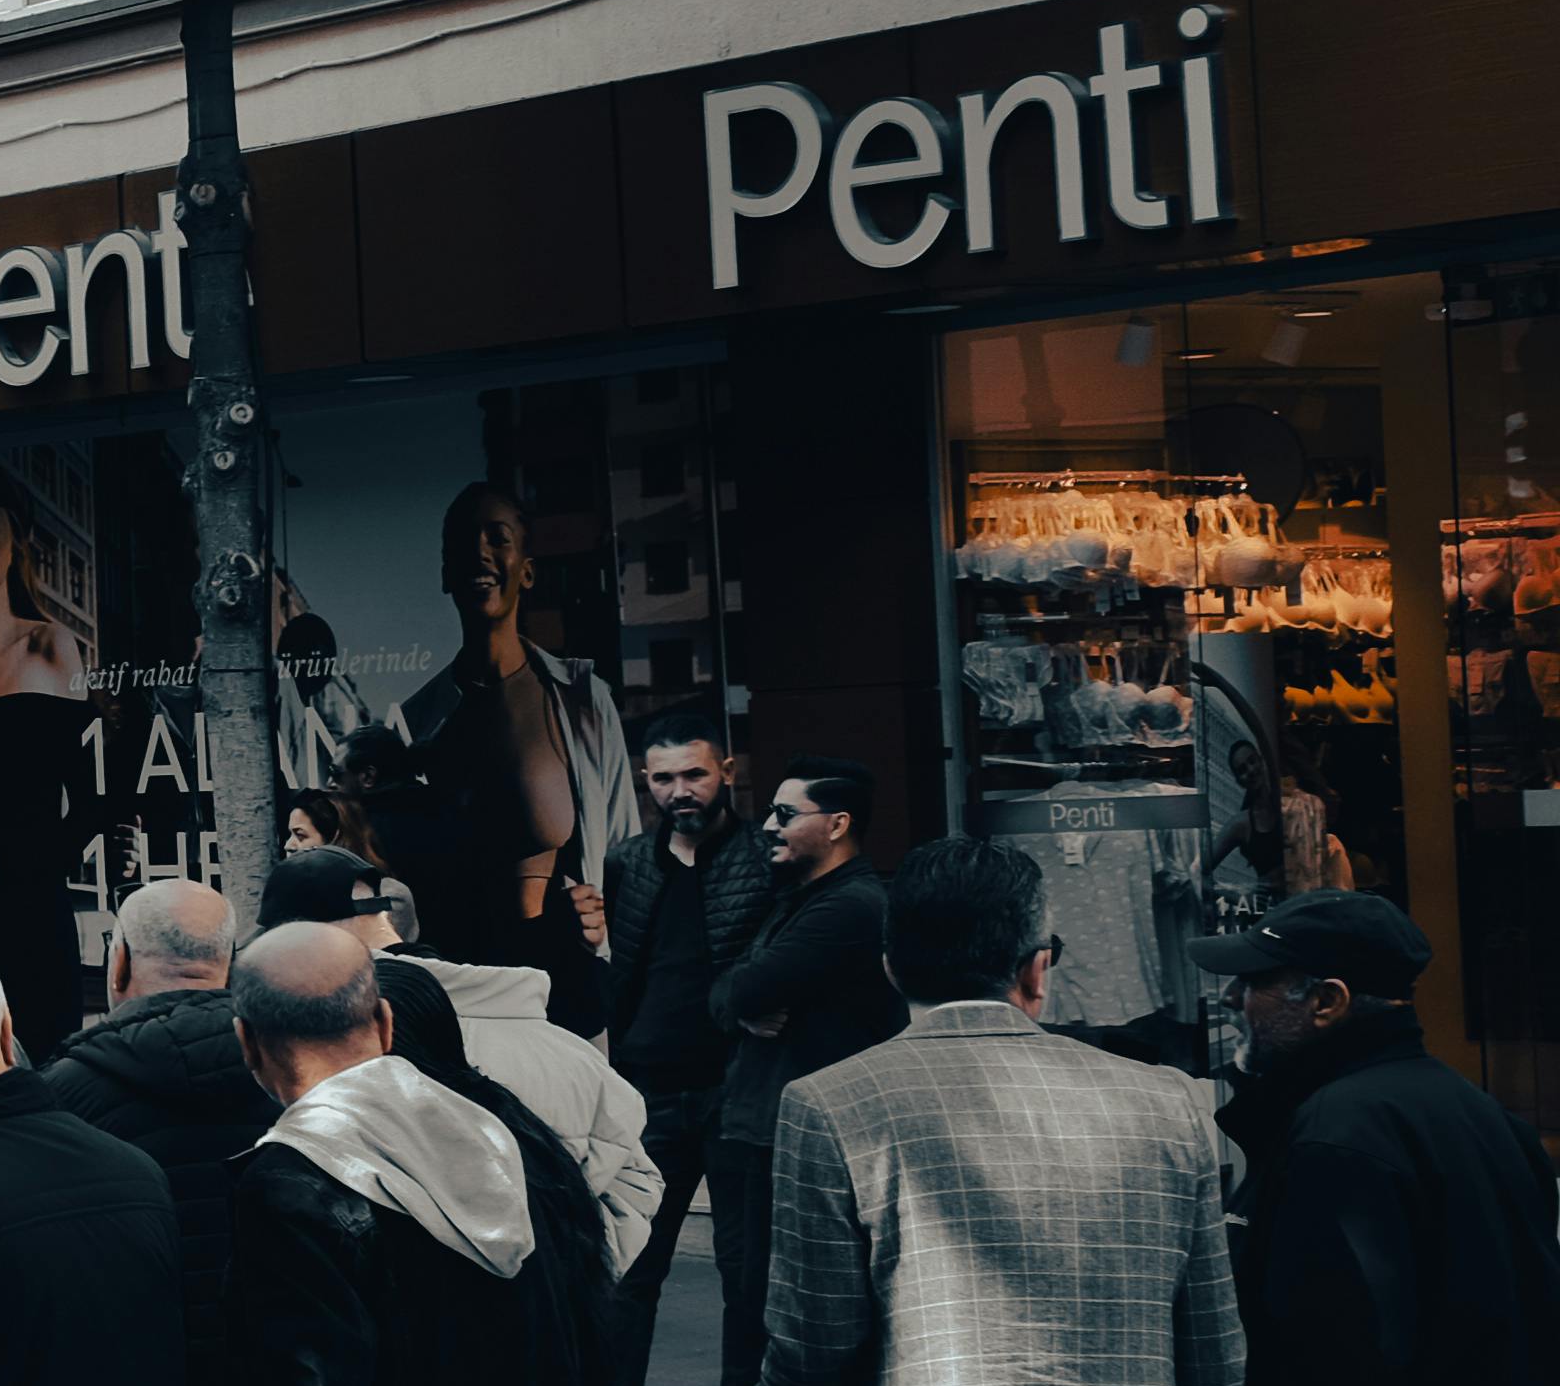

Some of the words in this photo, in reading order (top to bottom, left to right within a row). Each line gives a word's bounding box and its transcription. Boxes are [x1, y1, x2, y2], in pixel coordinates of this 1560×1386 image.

[703, 5, 1228, 291] Penti
[70, 660, 130, 697] aktif
[277, 646, 433, 680] ürünlerinde
[80, 716, 107, 797] 1
[1049, 800, 1116, 830] Penti
